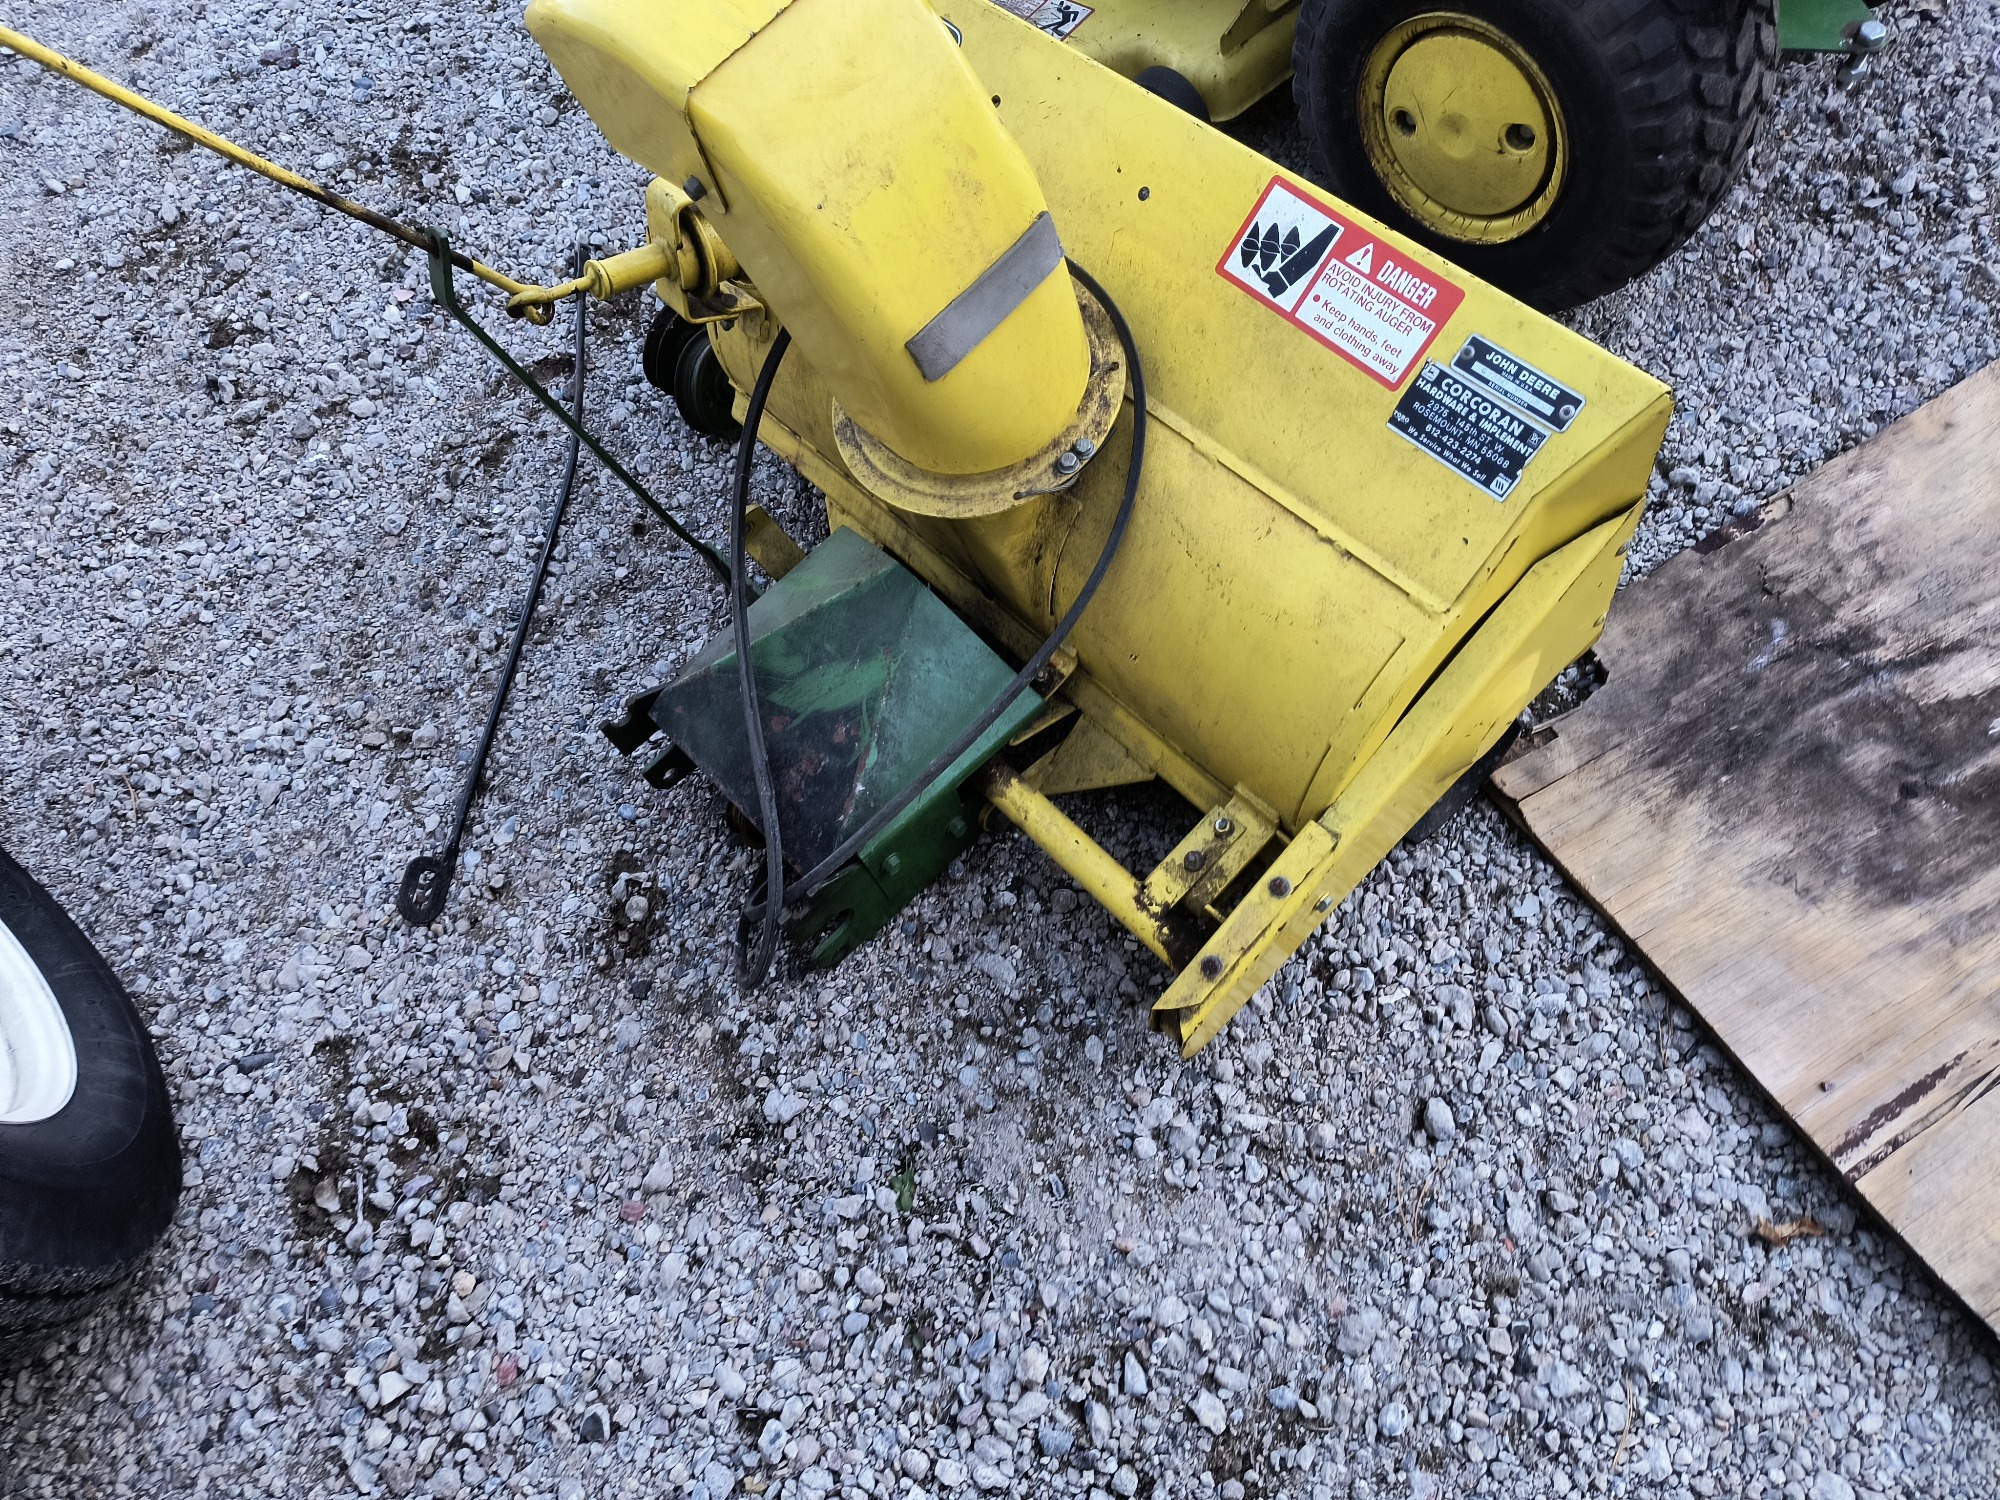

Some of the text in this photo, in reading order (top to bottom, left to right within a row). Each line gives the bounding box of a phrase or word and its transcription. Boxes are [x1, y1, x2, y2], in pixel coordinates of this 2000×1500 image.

[1320, 272, 1413, 336] ROTATING AUGER
[1327, 262, 1432, 333] AVOID INJURY FROM
[1375, 259, 1437, 309] DANGER
[1313, 313, 1399, 377] and clothing away
[1320, 298, 1402, 358] Keep hands, feet
[1485, 351, 1518, 374] JOHN
[1518, 369, 1560, 400] DEERE
[1487, 380, 1527, 408] SERIAL NUMBER
[1501, 370, 1514, 381] MADE
[1412, 400, 1463, 440] ROSEMOUNT,
[1464, 435, 1480, 449] MN
[1415, 377, 1469, 416] HARDWARE
[1467, 411, 1477, 423] &
[1478, 417, 1533, 456] IMPLEMENT
[1426, 399, 1449, 417] 2975
[1455, 417, 1477, 436] 145th
[1478, 432, 1492, 446] ST.
[1493, 441, 1505, 454] W.
[1440, 377, 1524, 436] CORCORAN
[1407, 425, 1418, 436] We
[1418, 433, 1441, 452] Service
[1442, 448, 1460, 464] What
[1460, 460, 1471, 472] We
[1472, 469, 1486, 481] Sell
